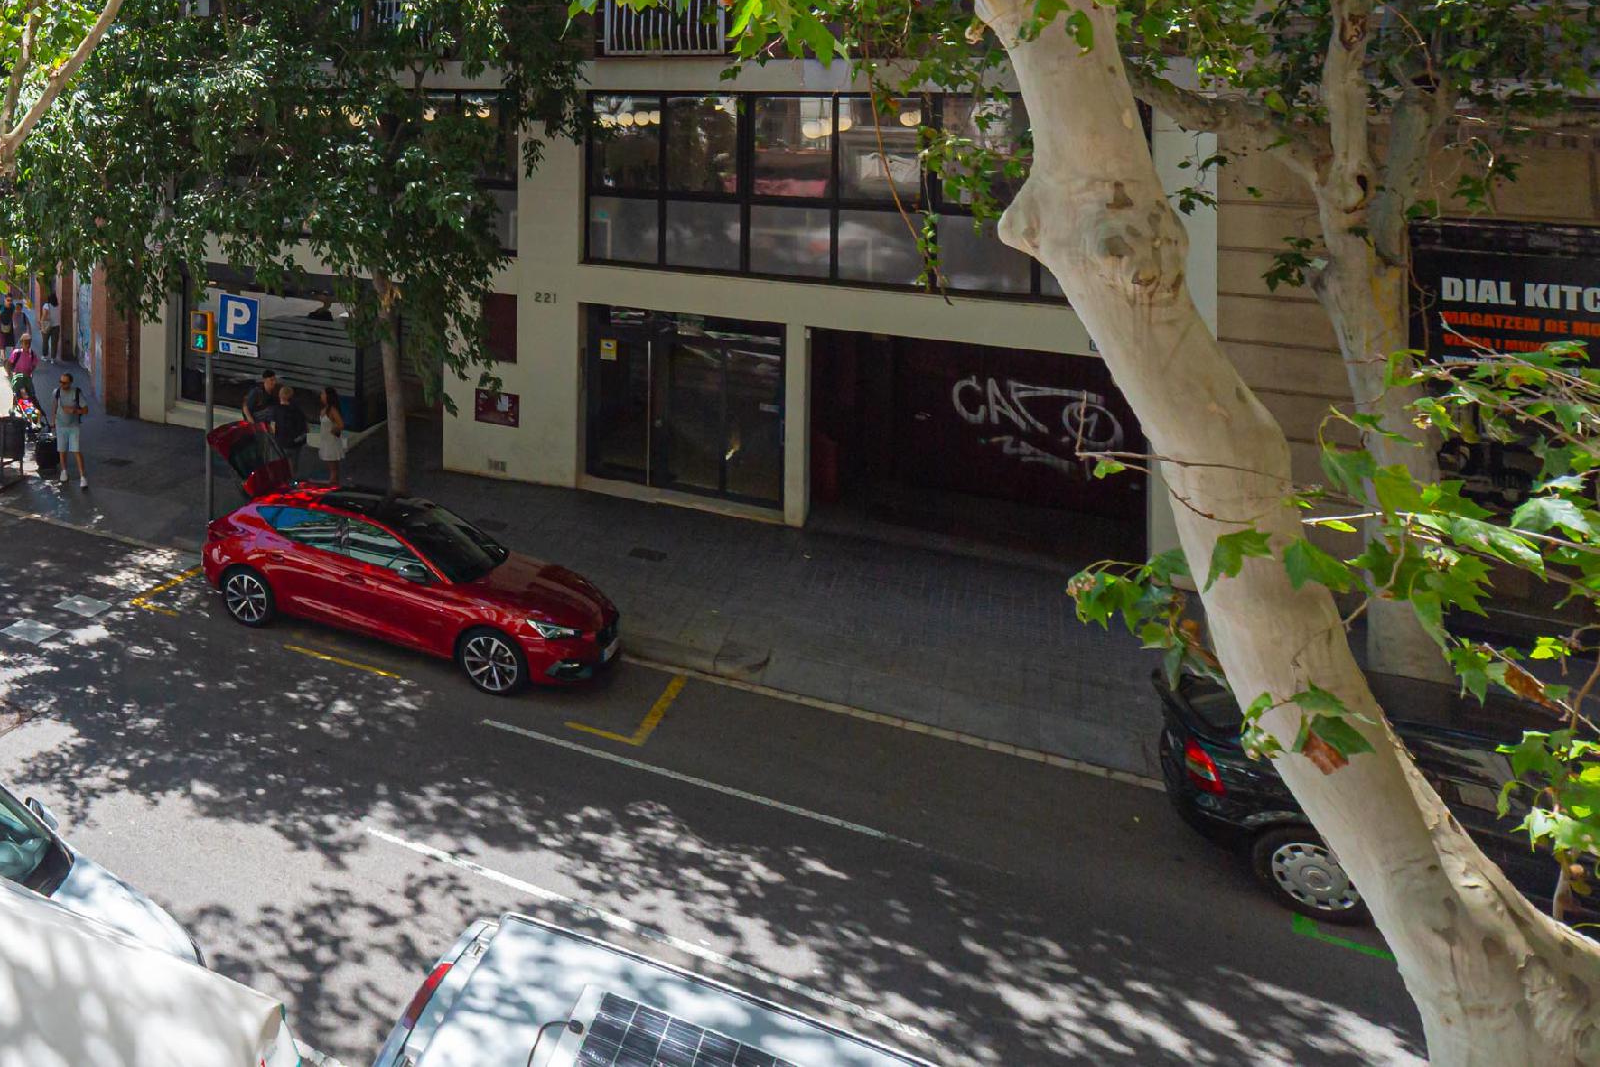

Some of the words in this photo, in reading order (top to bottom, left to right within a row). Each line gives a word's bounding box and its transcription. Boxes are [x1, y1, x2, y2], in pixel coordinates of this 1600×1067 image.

[534, 292, 557, 304] 221
[1441, 276, 1517, 305] DIAL
[226, 300, 251, 334] P
